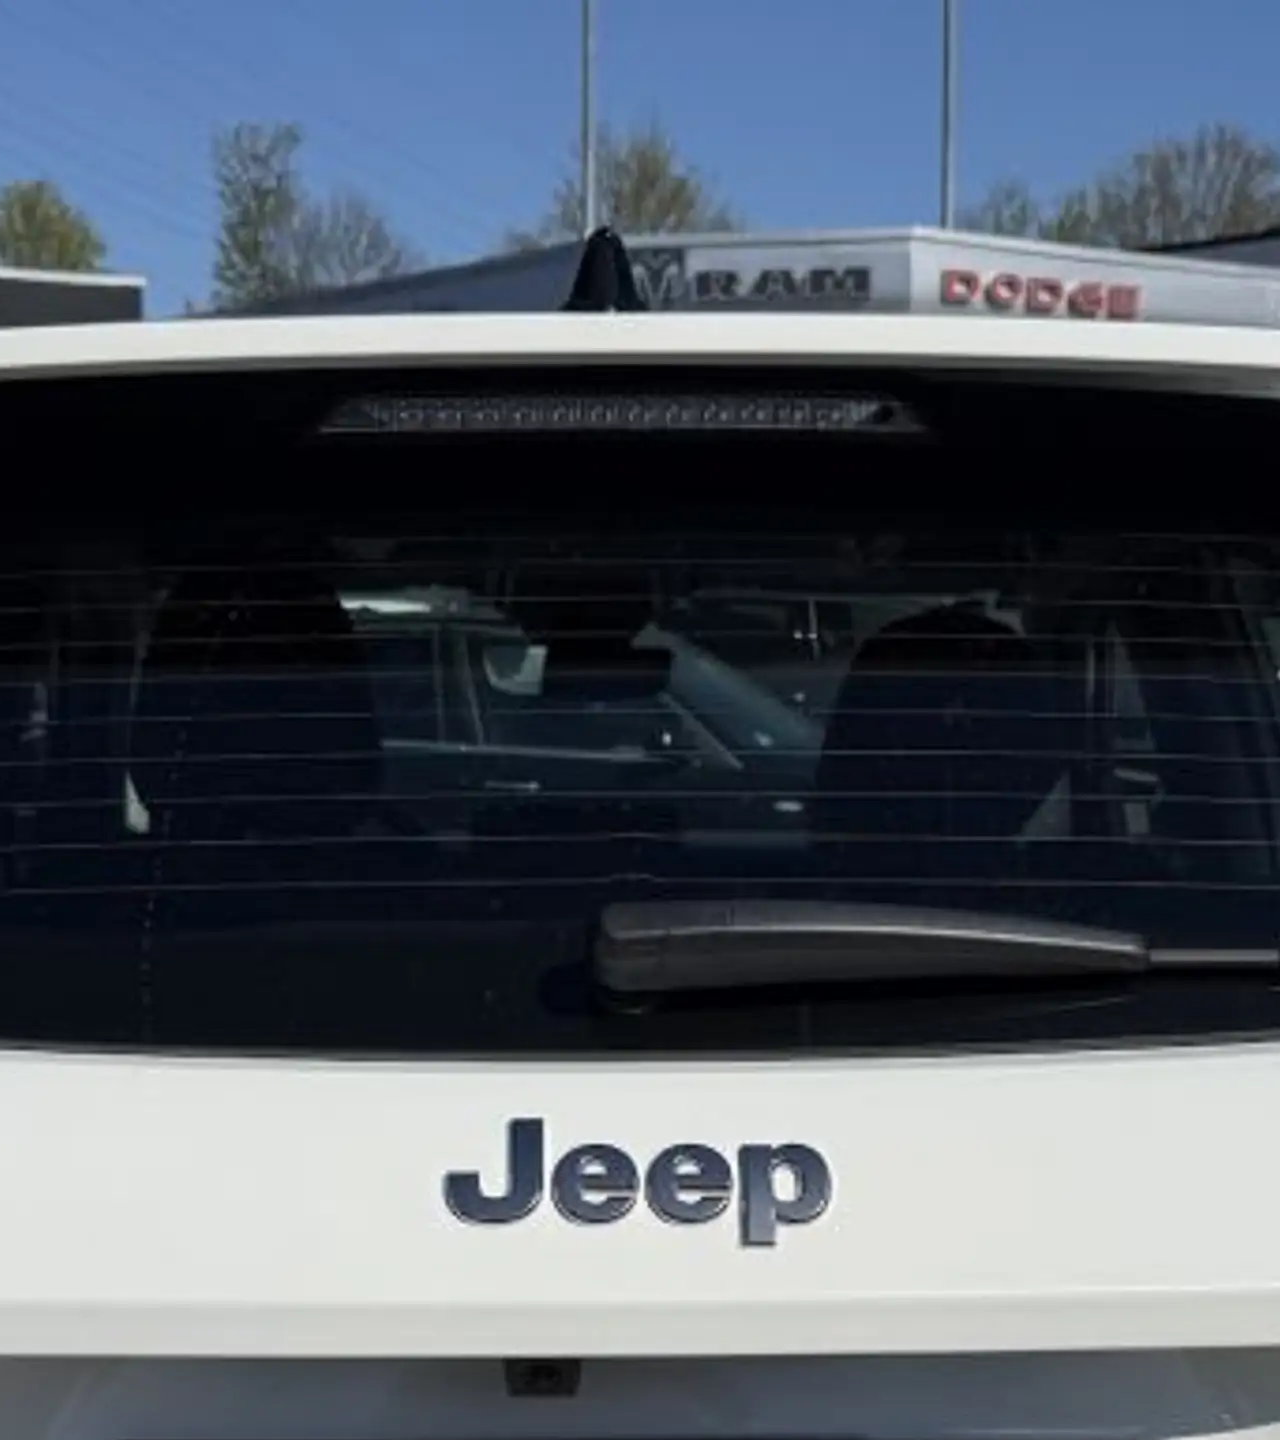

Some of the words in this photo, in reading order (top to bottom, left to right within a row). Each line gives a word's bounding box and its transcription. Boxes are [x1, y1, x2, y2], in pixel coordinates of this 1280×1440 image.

[694, 266, 871, 301] RAM
[939, 269, 1142, 322] DODGE
[442, 1116, 833, 1248] Jeep
